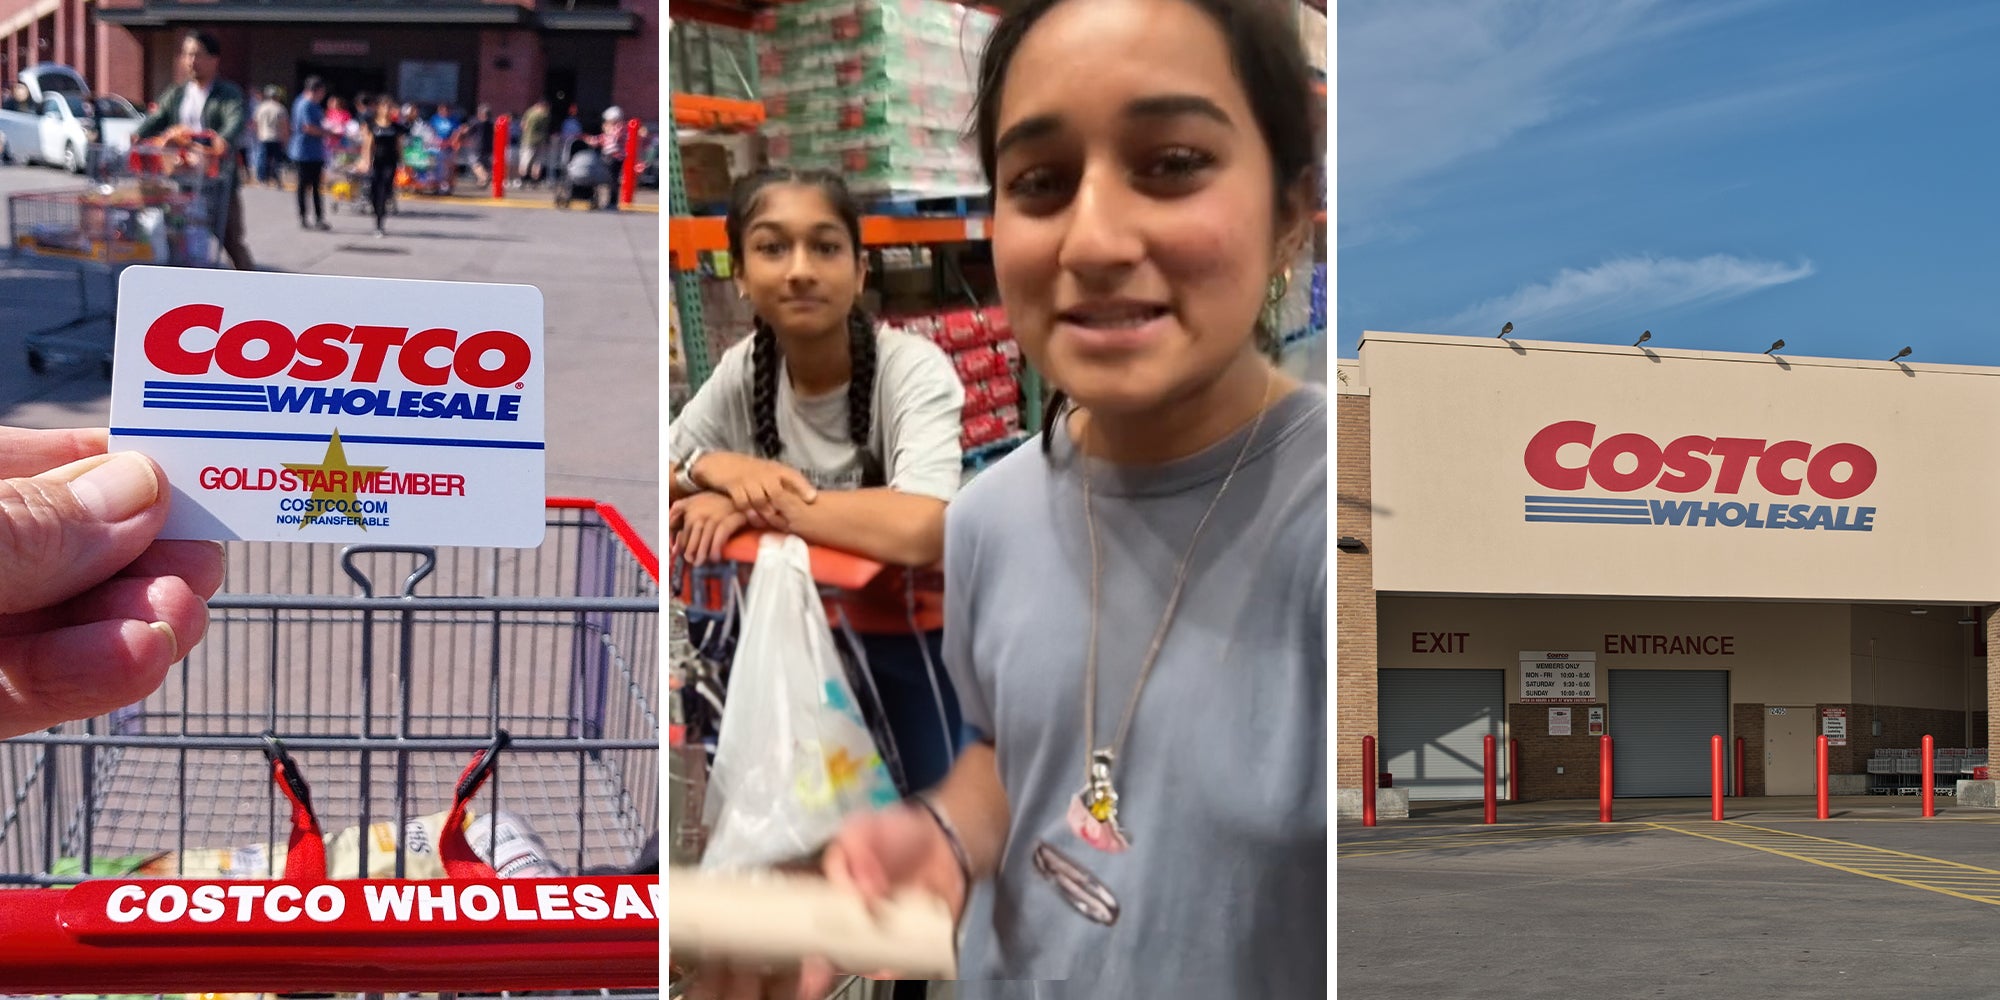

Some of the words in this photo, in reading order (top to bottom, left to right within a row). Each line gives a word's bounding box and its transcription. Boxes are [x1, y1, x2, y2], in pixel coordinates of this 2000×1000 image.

[144, 303, 531, 388] COSTCO
[267, 385, 521, 421] WHOLESALE
[1524, 420, 1877, 500] COSTCO
[199, 466, 277, 491] GOLD
[279, 468, 348, 493] STAR
[353, 470, 466, 497] MEMBER
[276, 514, 389, 526] NON-TRANSFERABLE
[280, 498, 388, 514] COSTCO.COM
[1649, 499, 1877, 532] WHOLESALE
[1411, 631, 1470, 654] EXIT
[1604, 634, 1735, 656] ENTRANCE
[106, 885, 346, 923] COSTCO
